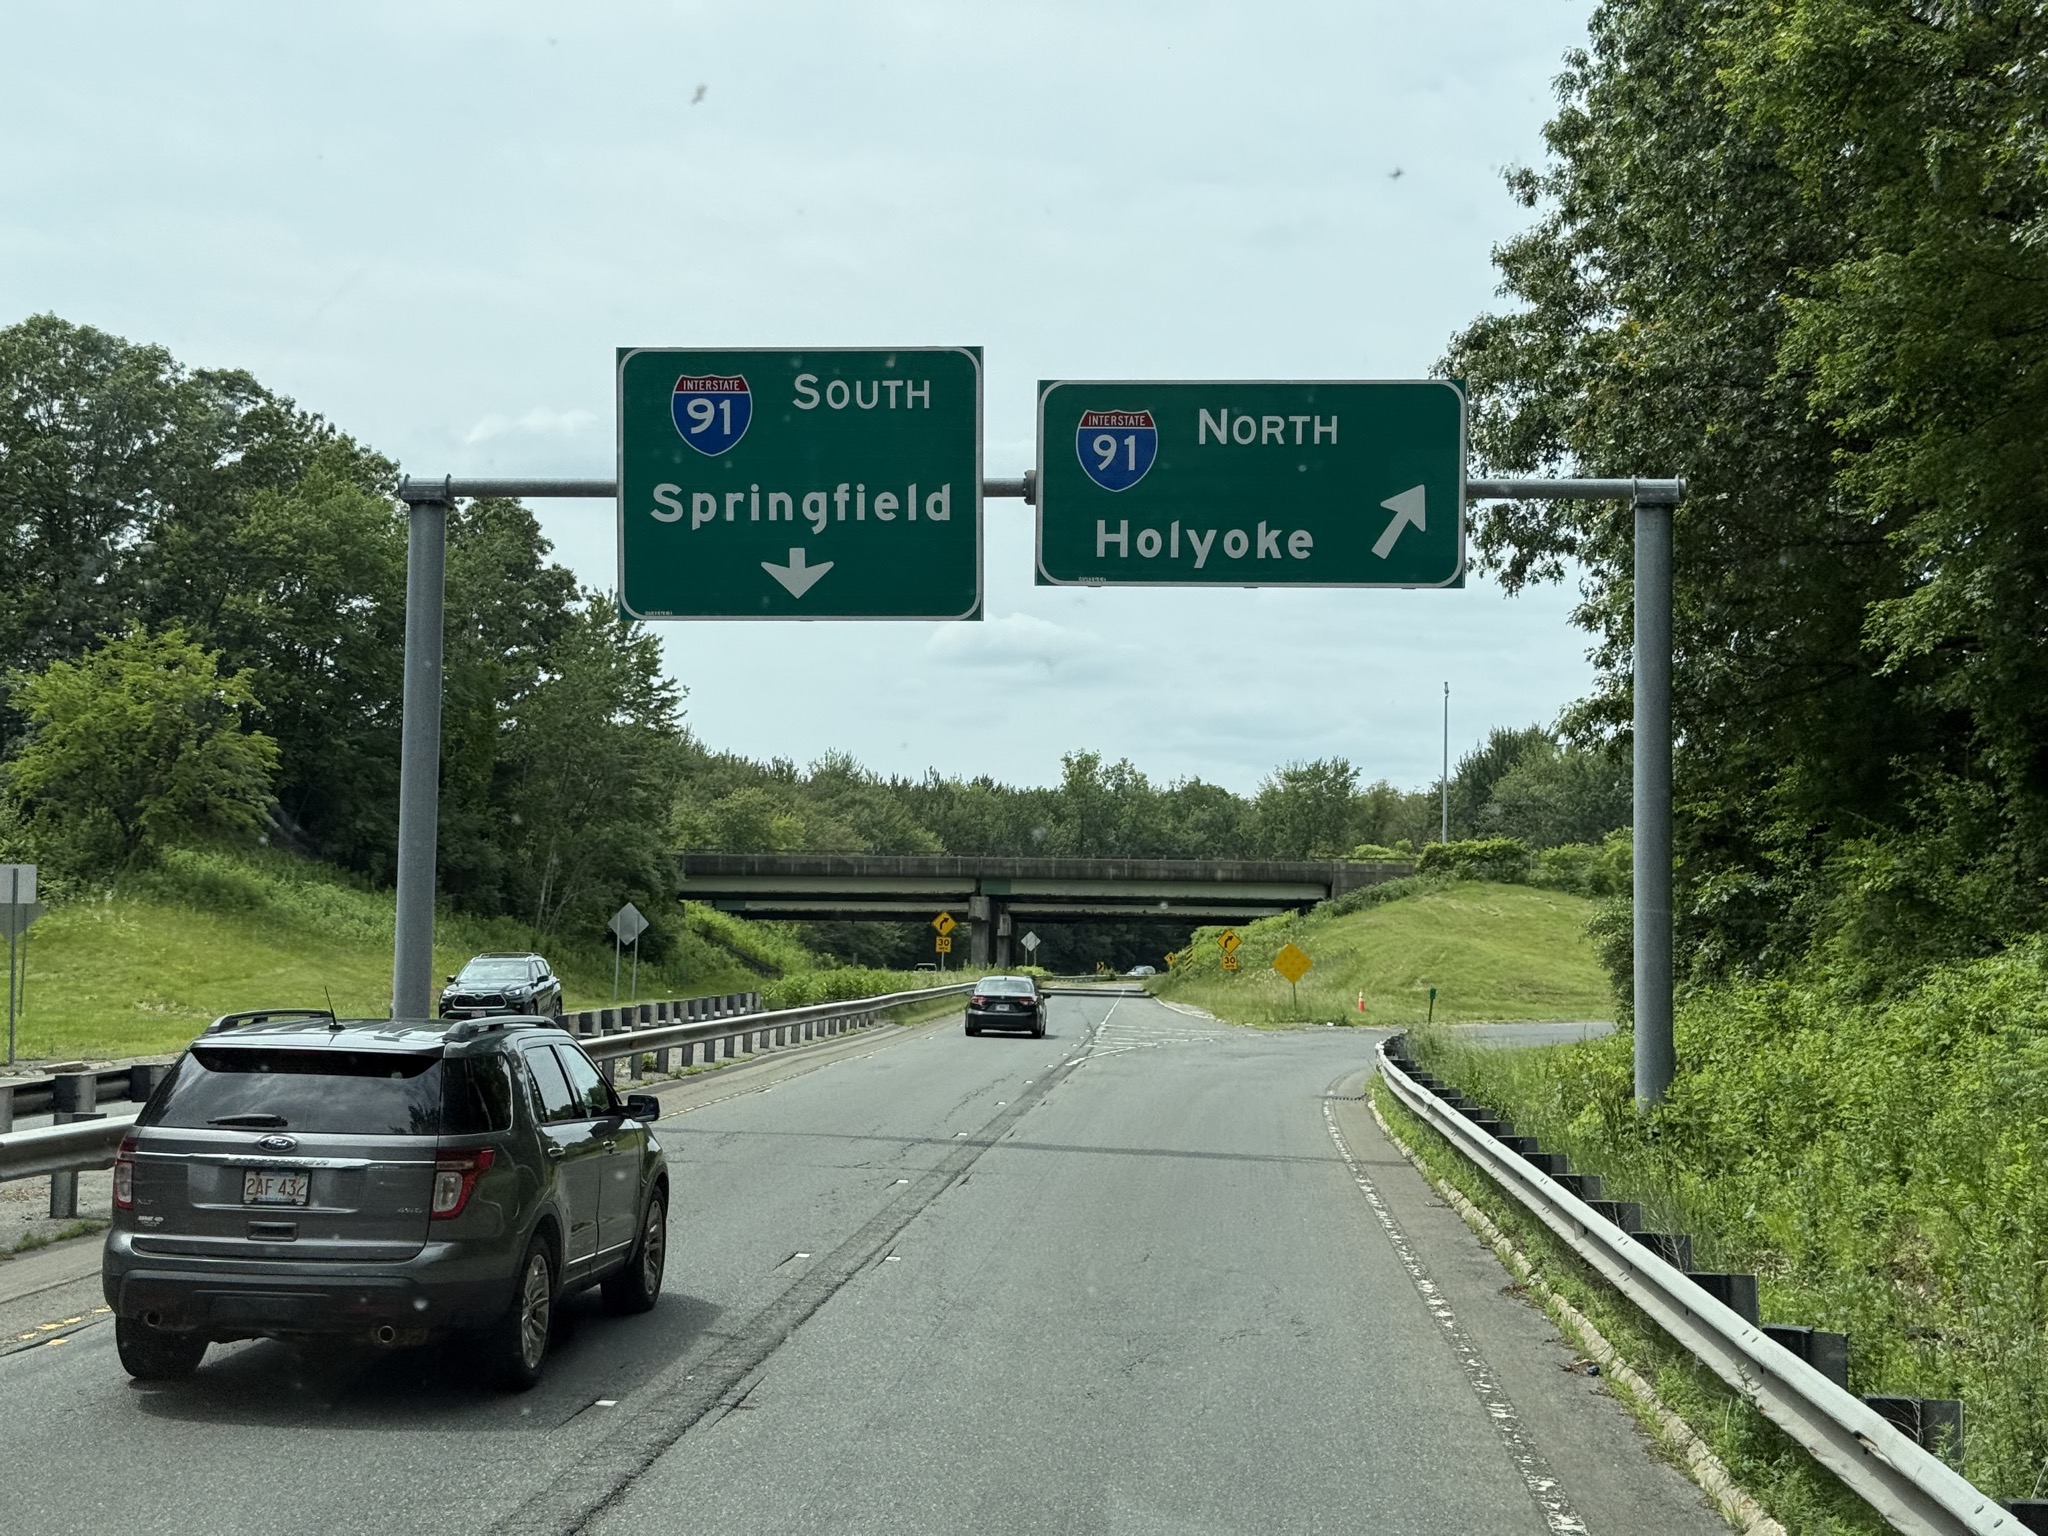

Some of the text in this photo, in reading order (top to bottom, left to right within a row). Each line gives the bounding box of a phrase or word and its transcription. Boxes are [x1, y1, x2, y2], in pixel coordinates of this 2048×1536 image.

[683, 380, 740, 391] INTERSTATE
[792, 373, 931, 410] SOUTH
[687, 398, 731, 435] 91
[1088, 415, 1146, 426] INTERSTATE
[1199, 408, 1338, 446] NORTH
[1093, 434, 1136, 471] 91
[650, 483, 950, 535] Springfield
[1096, 520, 1314, 569] Holyoke
[938, 938, 950, 947] 30
[1224, 956, 1236, 964] 30
